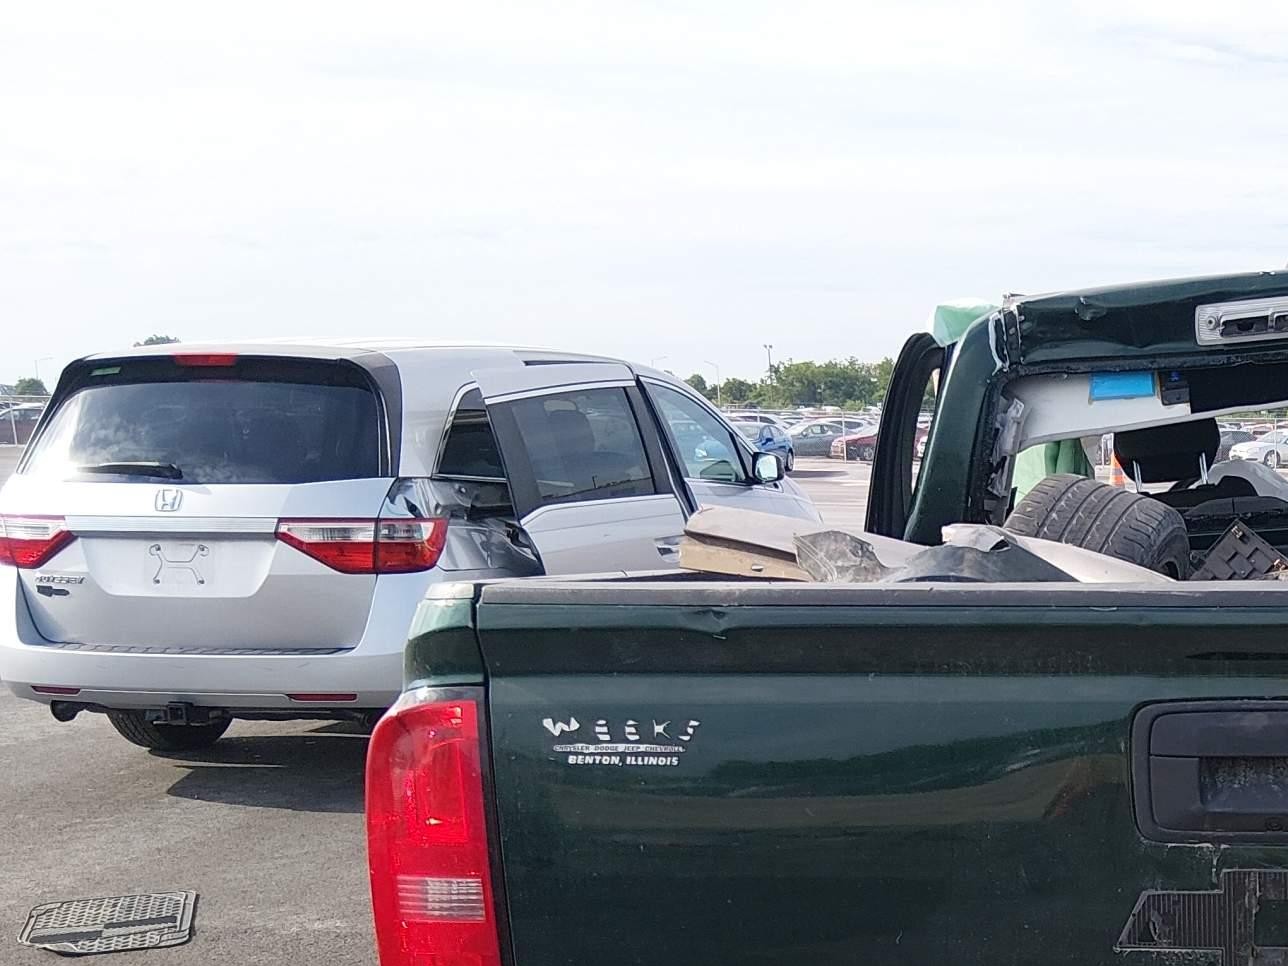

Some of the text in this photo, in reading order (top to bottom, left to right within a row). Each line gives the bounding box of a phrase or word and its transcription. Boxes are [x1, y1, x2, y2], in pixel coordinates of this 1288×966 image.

[594, 744, 619, 752] DODGE
[624, 744, 641, 752] JEEP
[568, 755, 679, 766] BENTON, ILLINOIS
